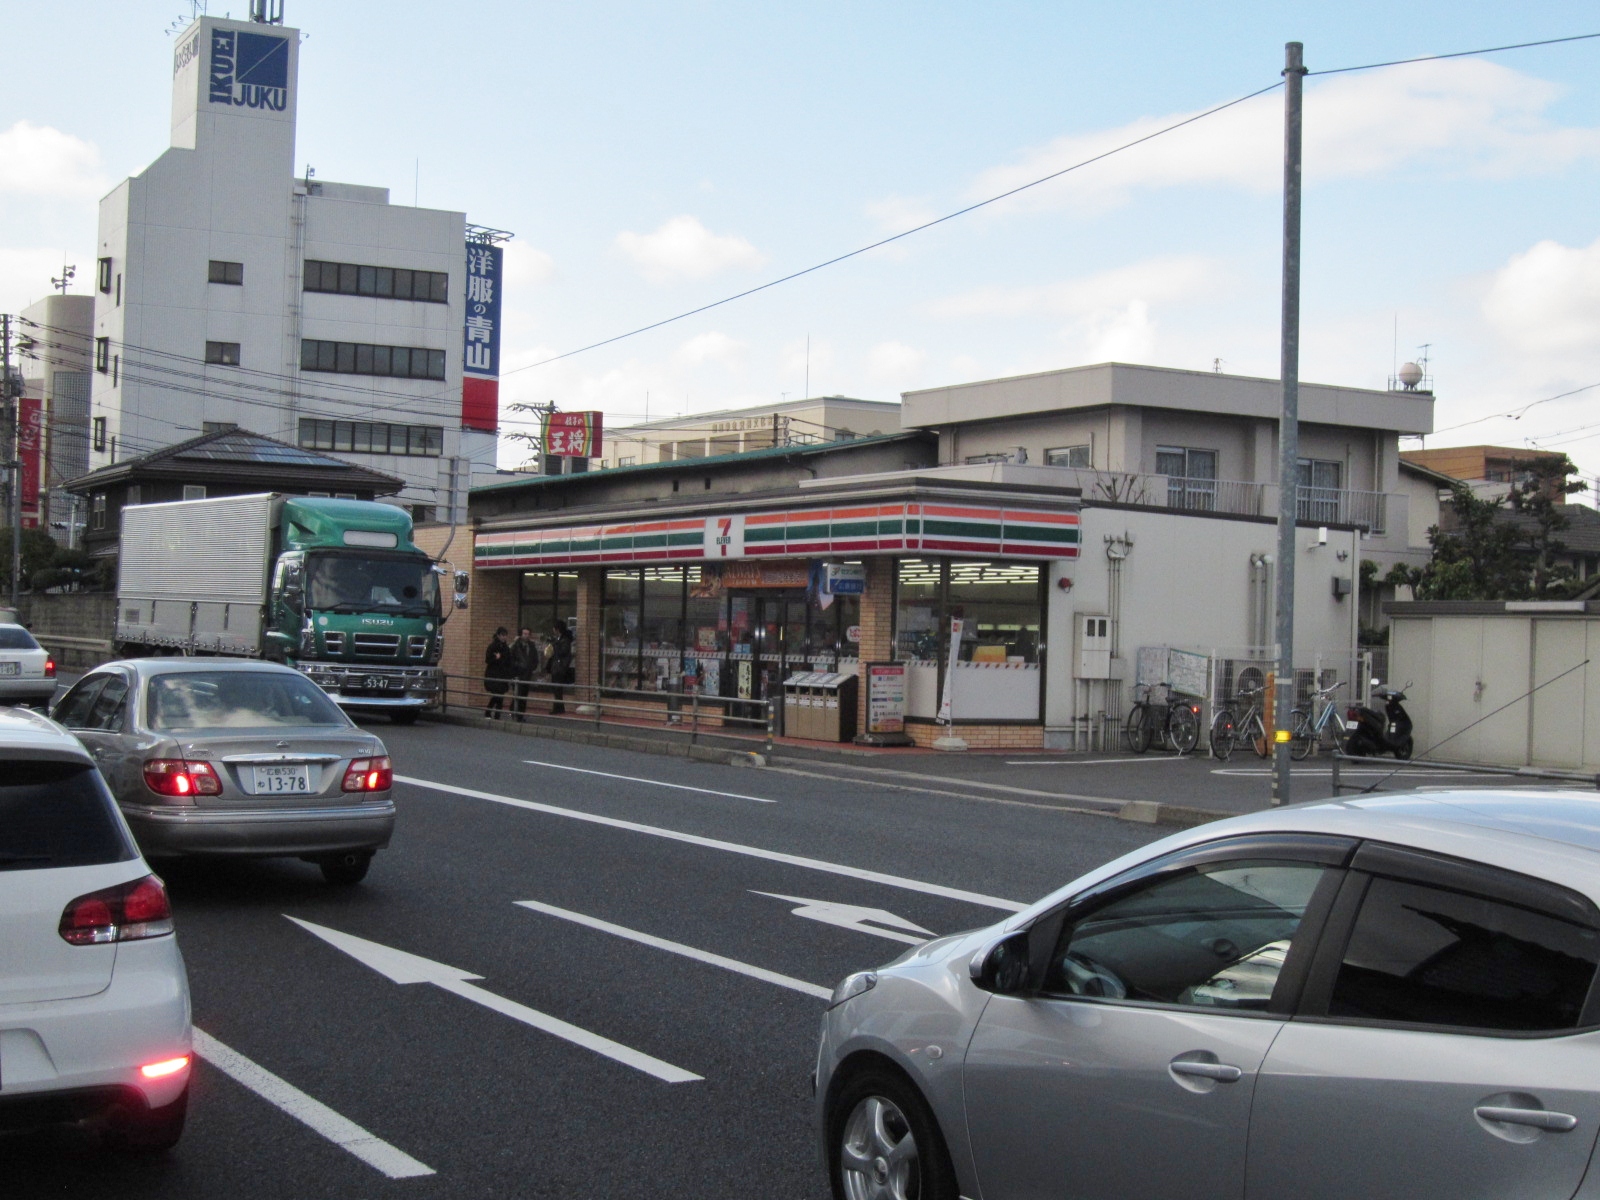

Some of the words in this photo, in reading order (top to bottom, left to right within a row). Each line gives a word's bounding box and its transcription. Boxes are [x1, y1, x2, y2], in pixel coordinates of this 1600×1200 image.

[209, 28, 236, 105] IKUEI
[233, 83, 287, 111] JUKU
[466, 247, 494, 370] 洋服の青山
[550, 429, 585, 454] 王将
[717, 517, 732, 556] 7
[362, 618, 394, 626] ISUZU
[367, 679, 389, 688] 53-47
[267, 777, 306, 791] 13-78
